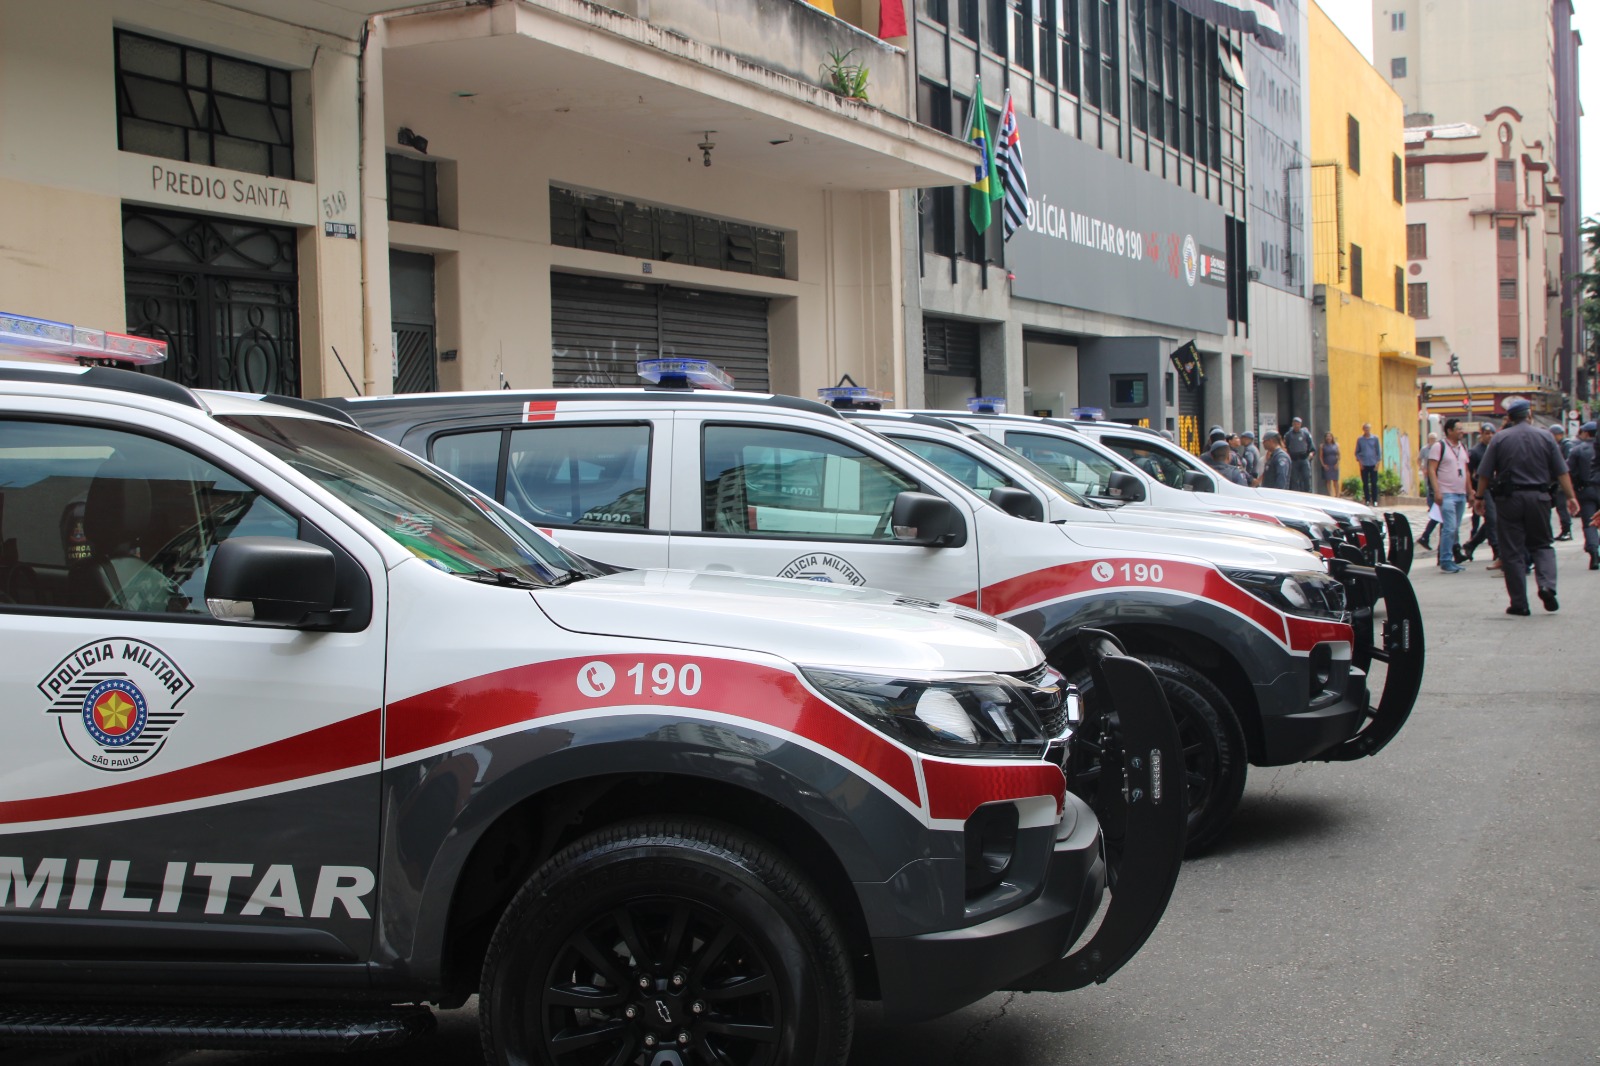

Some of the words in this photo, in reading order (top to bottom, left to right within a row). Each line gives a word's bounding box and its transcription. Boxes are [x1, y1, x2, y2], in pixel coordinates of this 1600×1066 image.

[152, 165, 226, 200] PREDIO
[232, 179, 290, 210] SANTA
[322, 190, 347, 219] 510
[1026, 194, 1068, 241] OLÍCIA
[1070, 211, 1116, 254] MILITAR
[1125, 230, 1142, 261] 190
[781, 556, 818, 579] OLÍCIA
[822, 556, 860, 586] MILITAR
[1120, 562, 1164, 583] 190
[48, 643, 114, 695] POLÍCIA
[122, 643, 184, 695] MILITAR
[627, 662, 702, 696] 190
[91, 754, 109, 766] SÃO
[111, 755, 139, 767] PAULO
[0, 856, 376, 920] MILITAR
